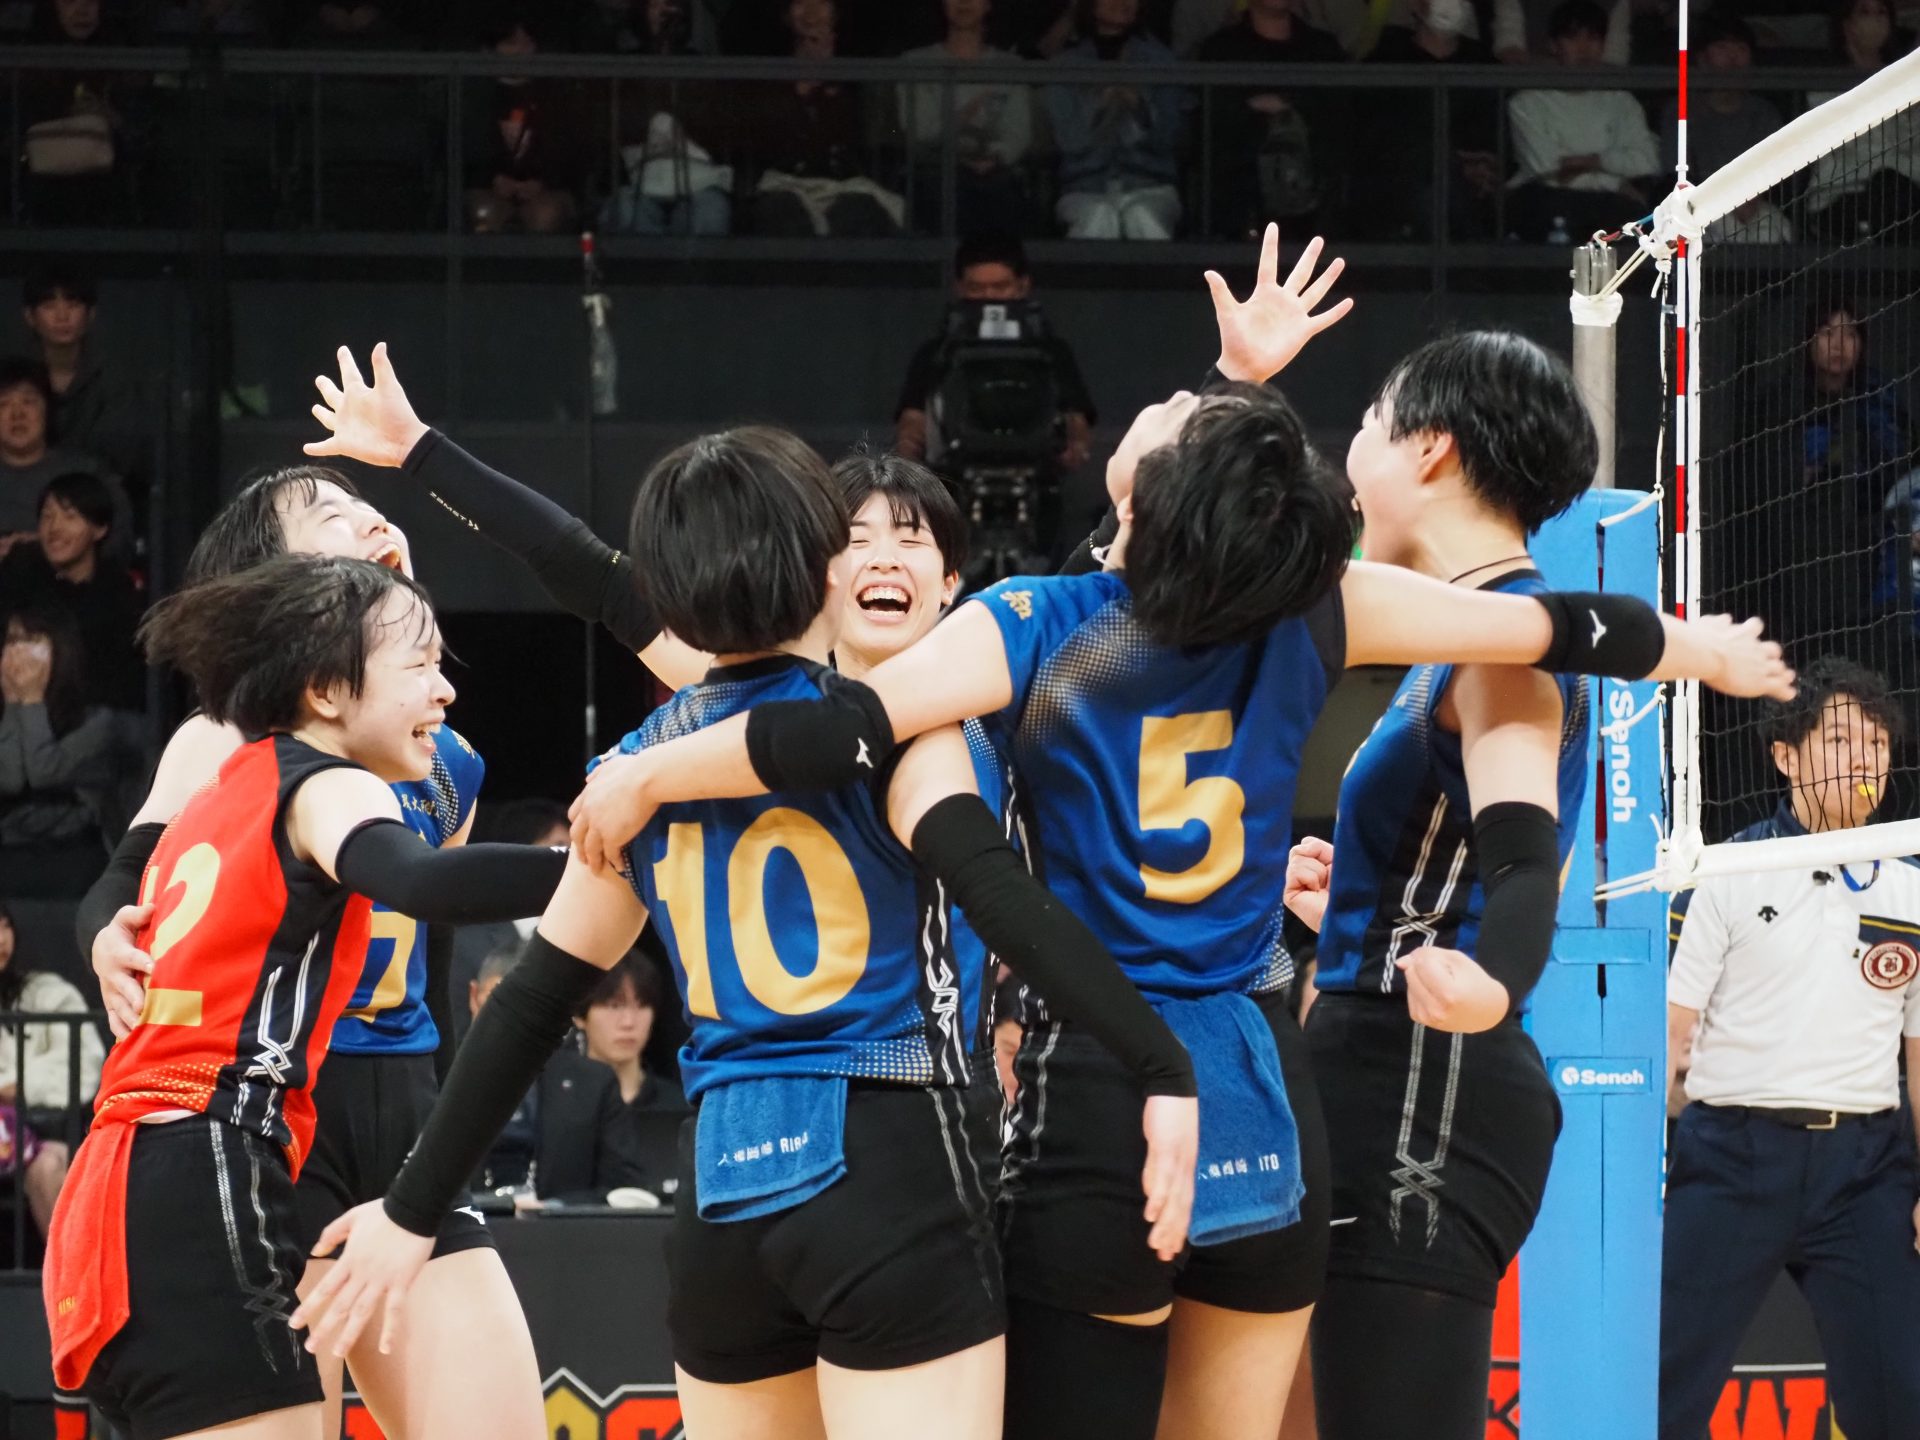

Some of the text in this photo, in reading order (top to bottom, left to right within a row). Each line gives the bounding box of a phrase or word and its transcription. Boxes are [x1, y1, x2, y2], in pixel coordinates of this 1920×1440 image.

[1138, 709, 1246, 905] 5
[1609, 689, 1637, 823] Senoh
[653, 806, 871, 1020] 10
[1580, 1069, 1645, 1086] Senoh
[1259, 1153, 1280, 1172] ITO
